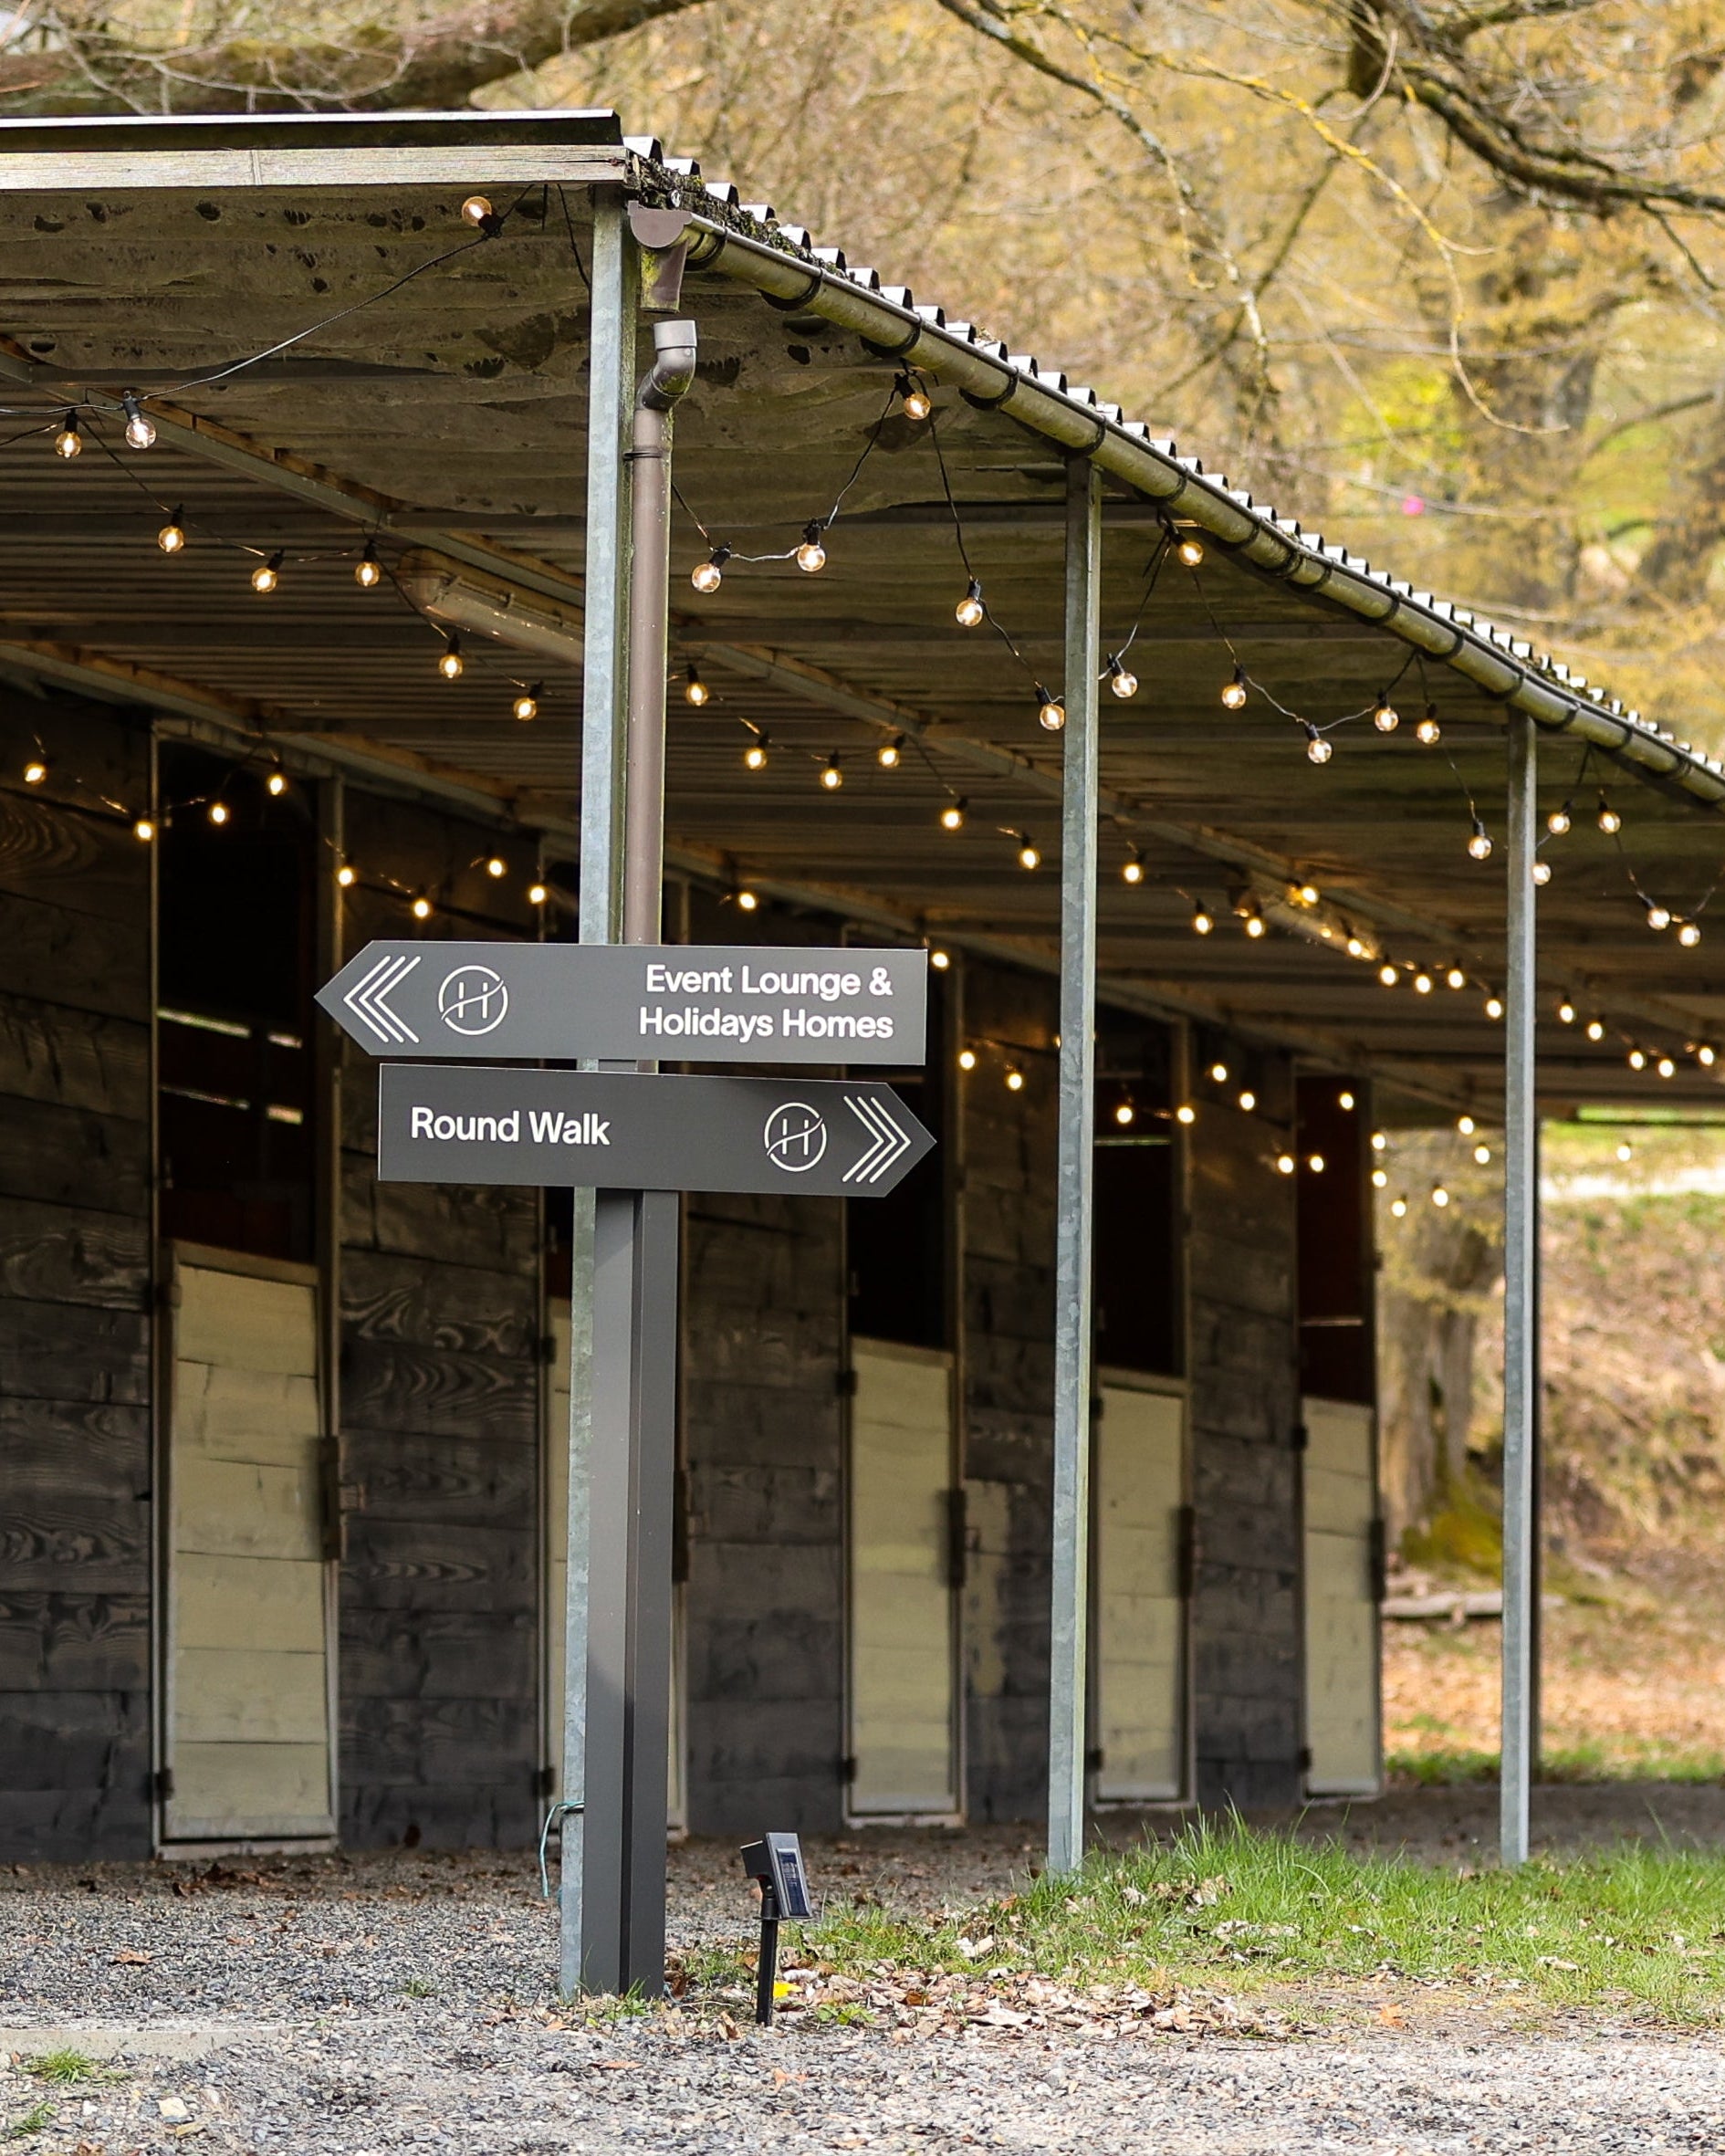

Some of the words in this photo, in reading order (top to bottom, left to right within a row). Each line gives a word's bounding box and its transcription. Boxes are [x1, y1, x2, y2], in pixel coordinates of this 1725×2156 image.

[646, 963, 734, 994] Event
[741, 965, 862, 1000] Lounge
[868, 966, 894, 997] &
[639, 1006, 774, 1043] Holidays
[782, 1008, 894, 1040] Homes
[411, 1106, 520, 1143] Round
[528, 1110, 611, 1146] Walk
